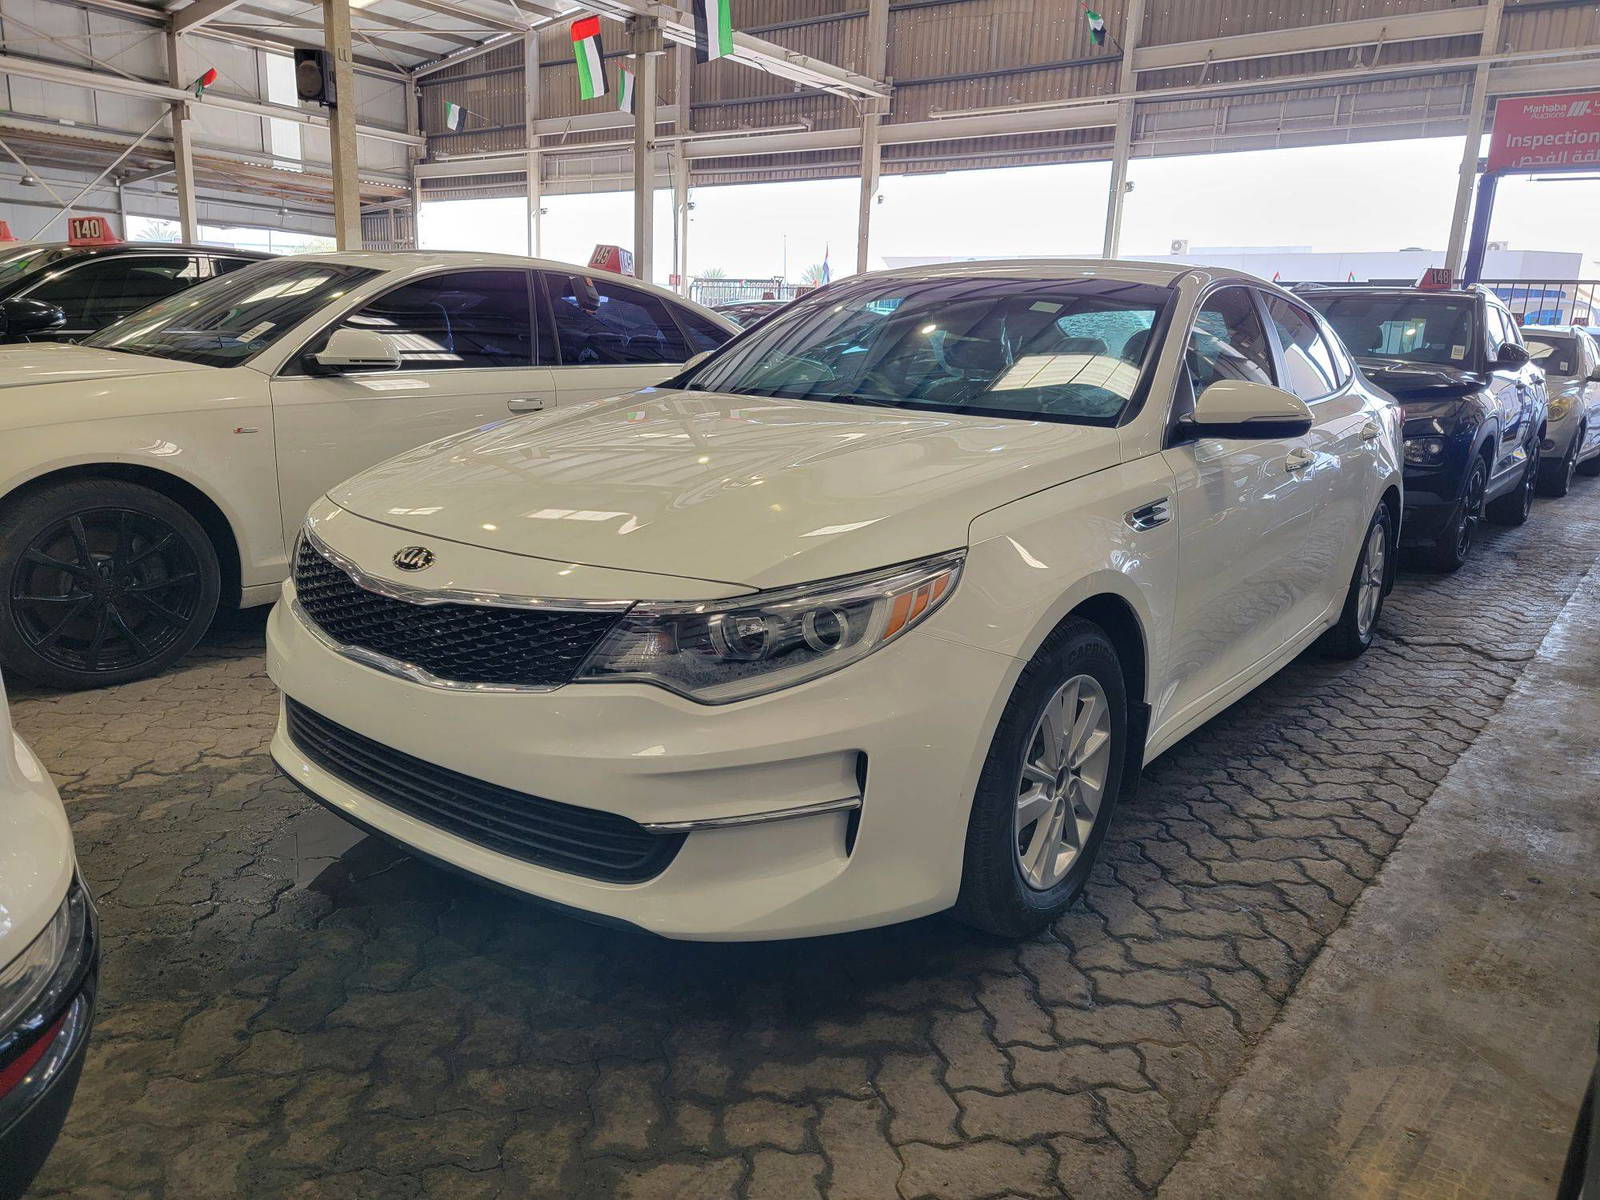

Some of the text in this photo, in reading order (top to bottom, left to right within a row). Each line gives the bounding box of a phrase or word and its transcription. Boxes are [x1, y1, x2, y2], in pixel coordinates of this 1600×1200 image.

[1523, 103, 1567, 113] Marhaba
[1506, 130, 1600, 150] Inspection
[74, 219, 100, 239] 140
[395, 548, 429, 568] KIA
